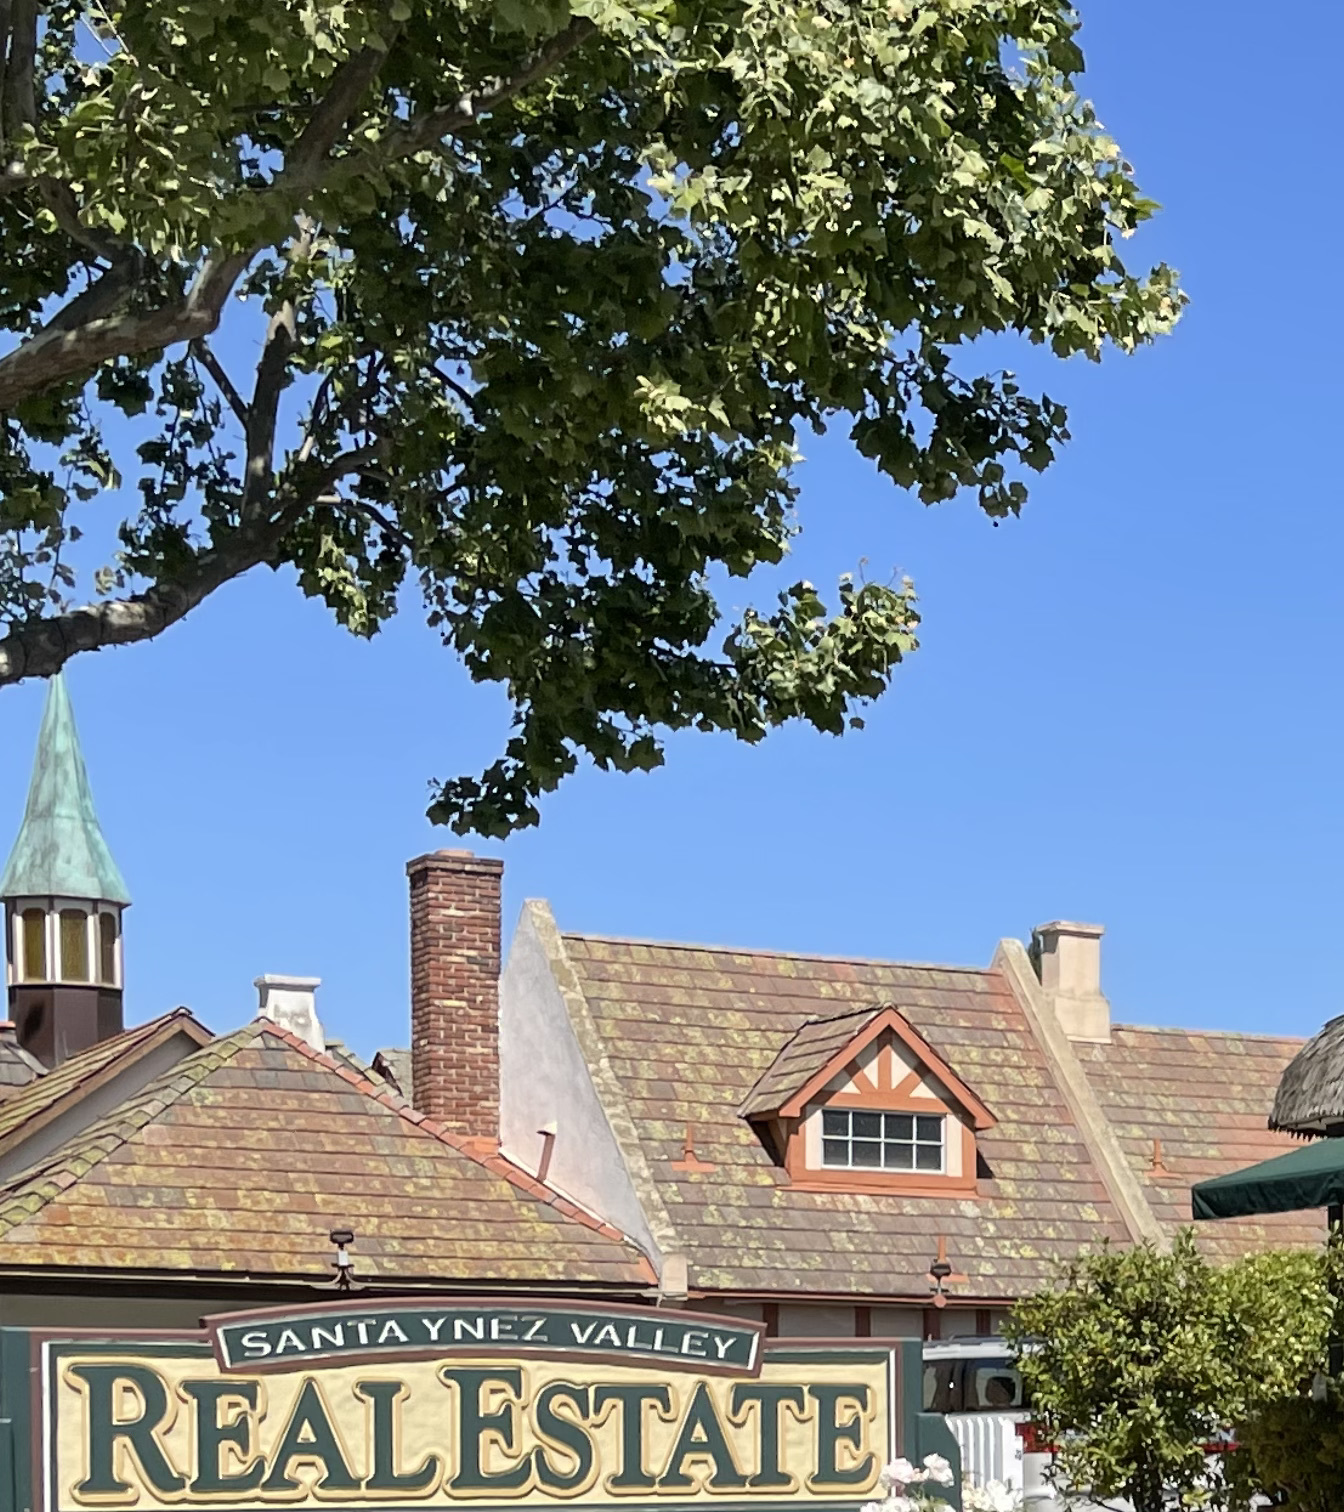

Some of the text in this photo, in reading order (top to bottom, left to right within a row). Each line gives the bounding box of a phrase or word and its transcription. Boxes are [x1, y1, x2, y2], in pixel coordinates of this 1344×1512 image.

[241, 1316, 738, 1360] SANTA YNEZ VALLEY
[67, 1361, 881, 1503] REAL ESTATE
